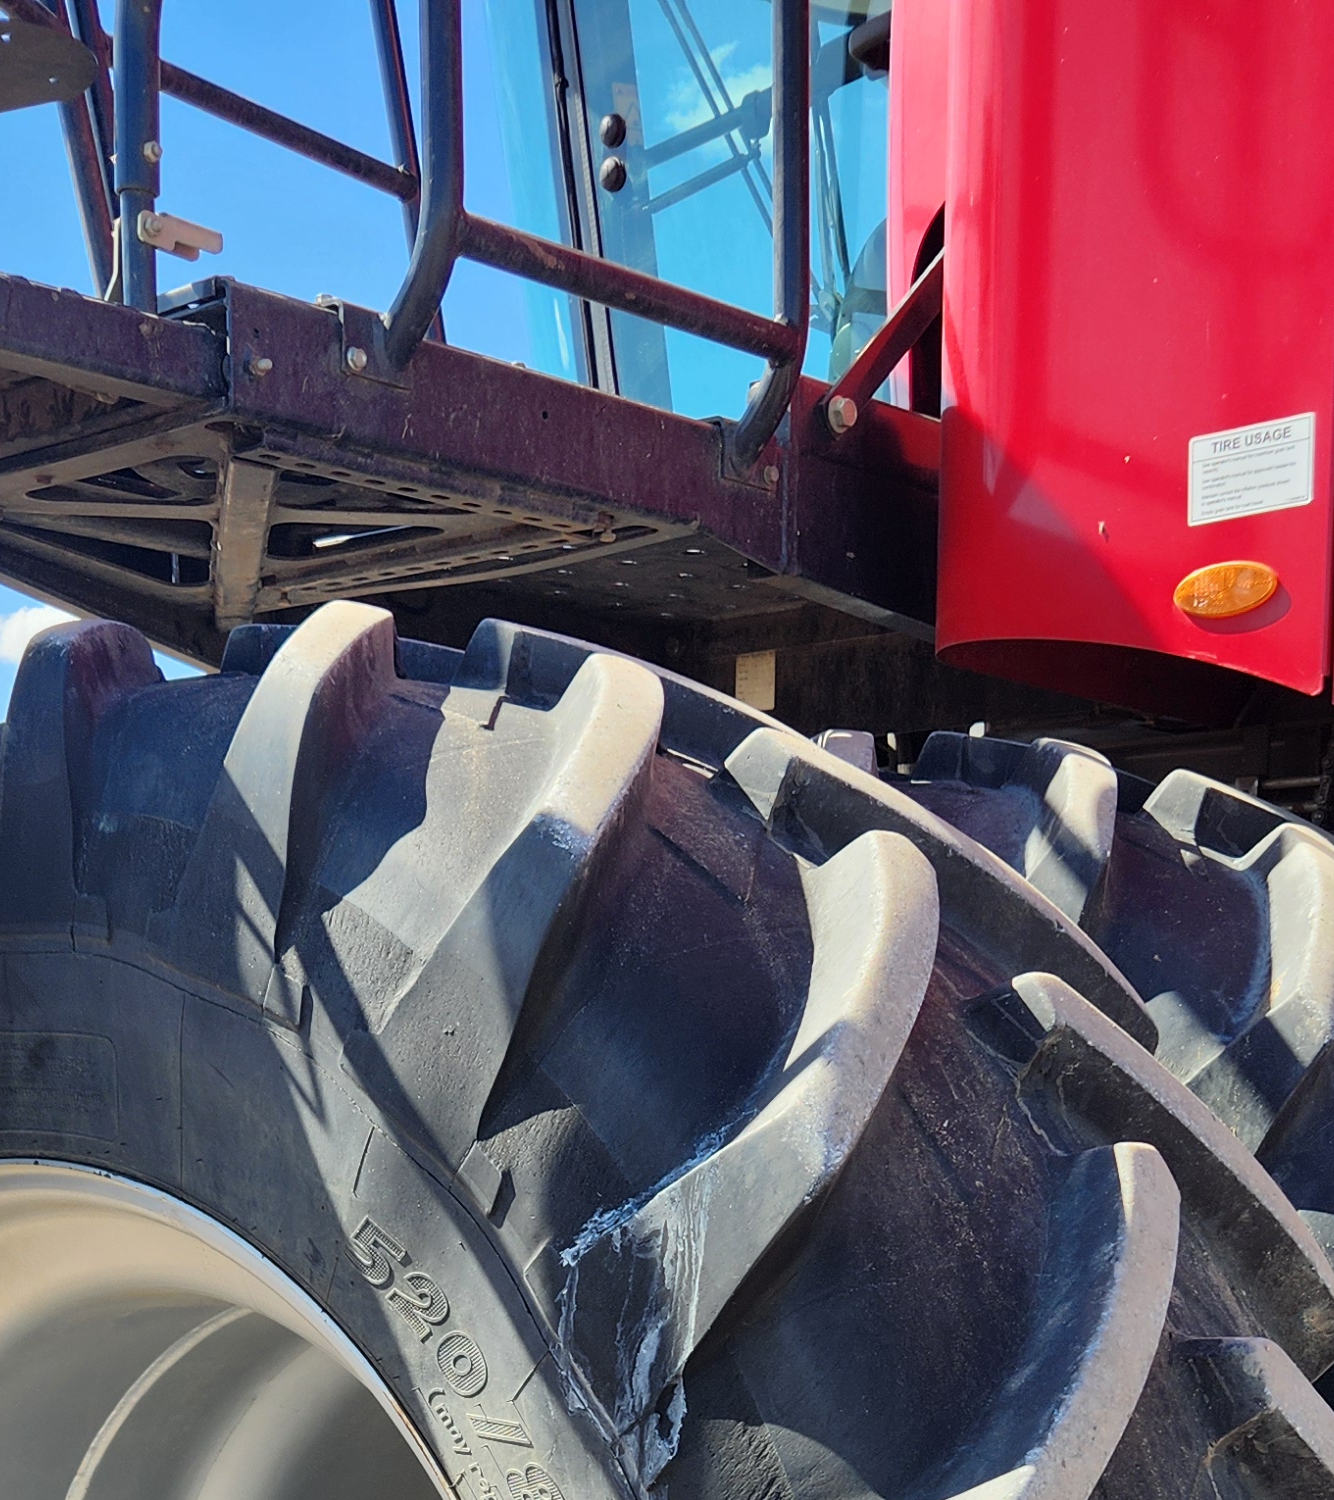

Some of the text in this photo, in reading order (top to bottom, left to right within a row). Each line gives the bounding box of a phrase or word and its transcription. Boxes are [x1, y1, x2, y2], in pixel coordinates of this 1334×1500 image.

[1212, 436, 1242, 454] TIRE
[1245, 425, 1292, 447] USAGE
[427, 1387, 472, 1456] (may
